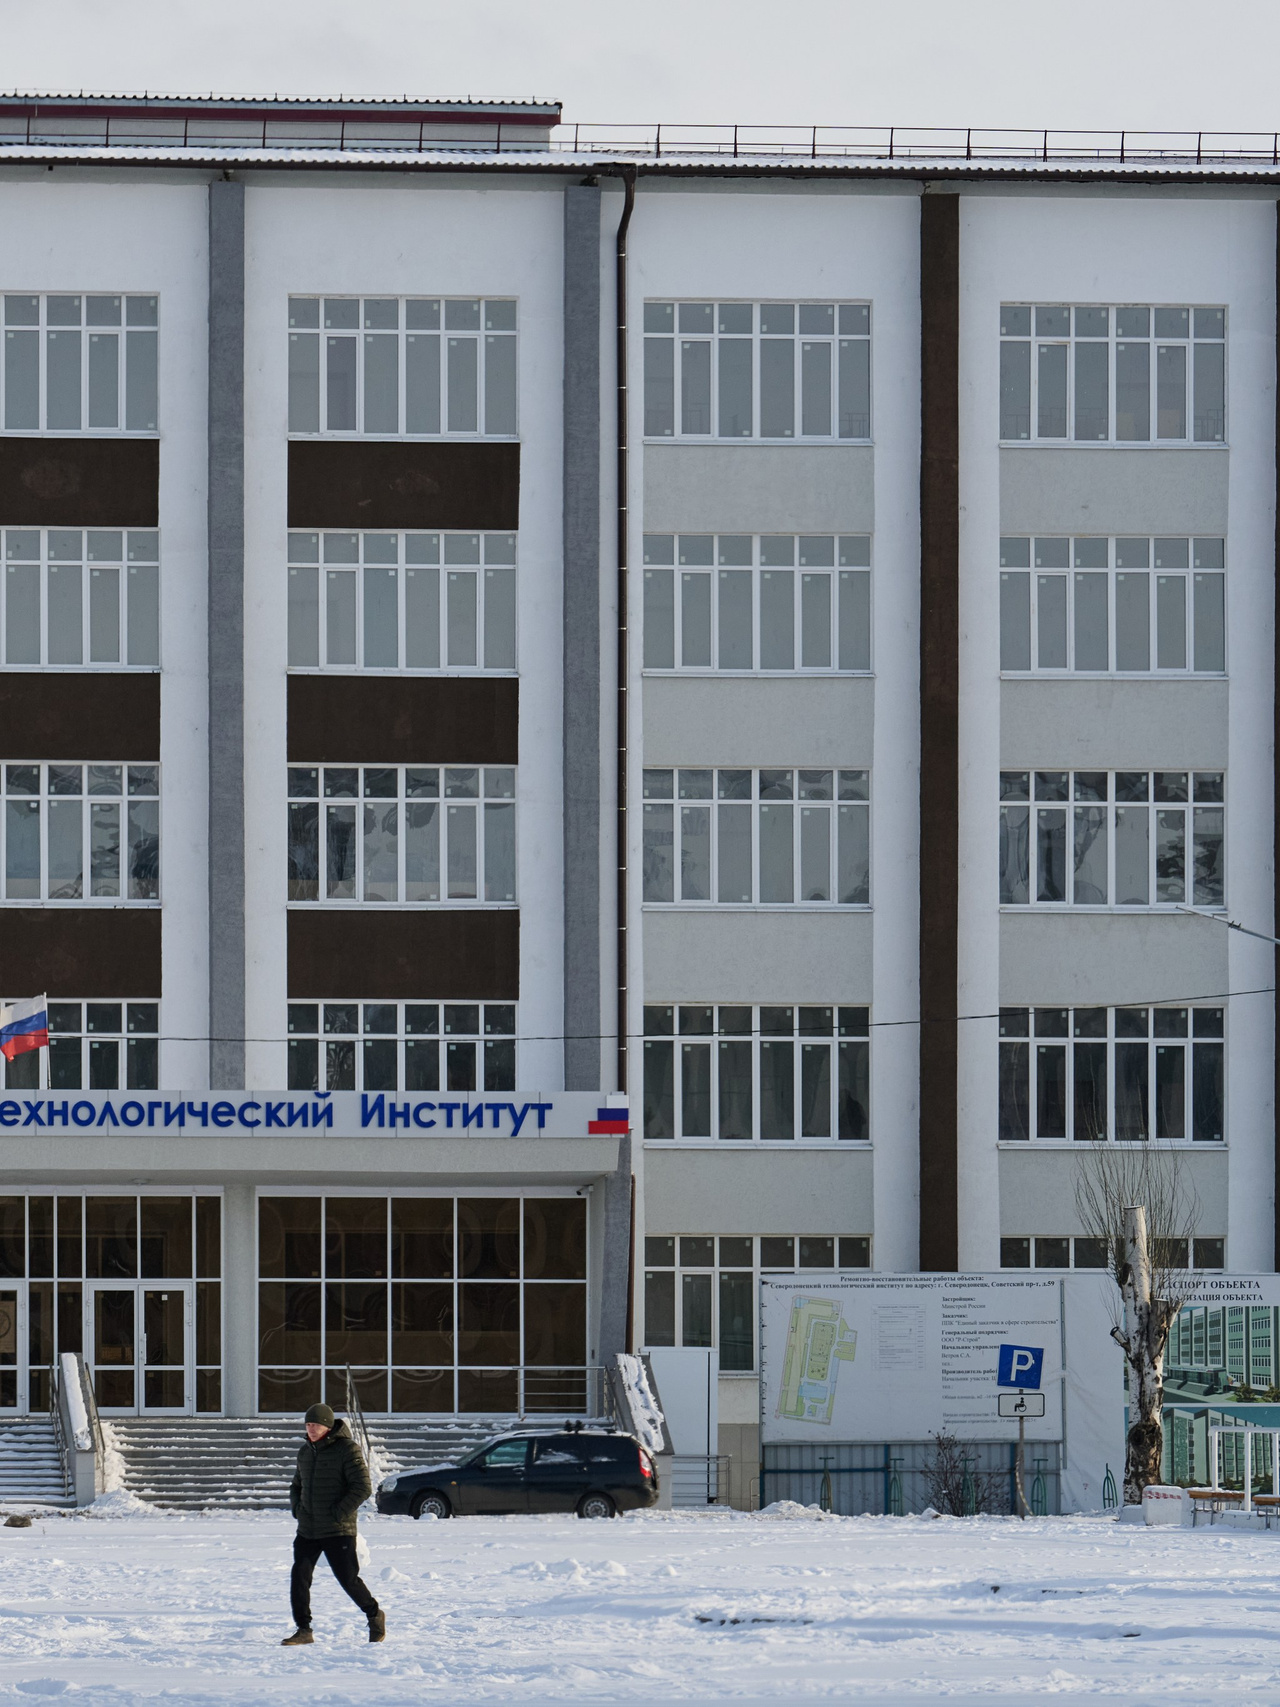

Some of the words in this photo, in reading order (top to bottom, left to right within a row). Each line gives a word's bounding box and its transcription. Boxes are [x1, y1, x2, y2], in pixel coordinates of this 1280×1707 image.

[361, 1093, 554, 1137] Институт
[770, 1282, 821, 1290] Северодонецкий
[876, 1282, 904, 1290] институт
[1210, 1280, 1261, 1289] ОБЪЕКТА
[1010, 1350, 1034, 1381] P
